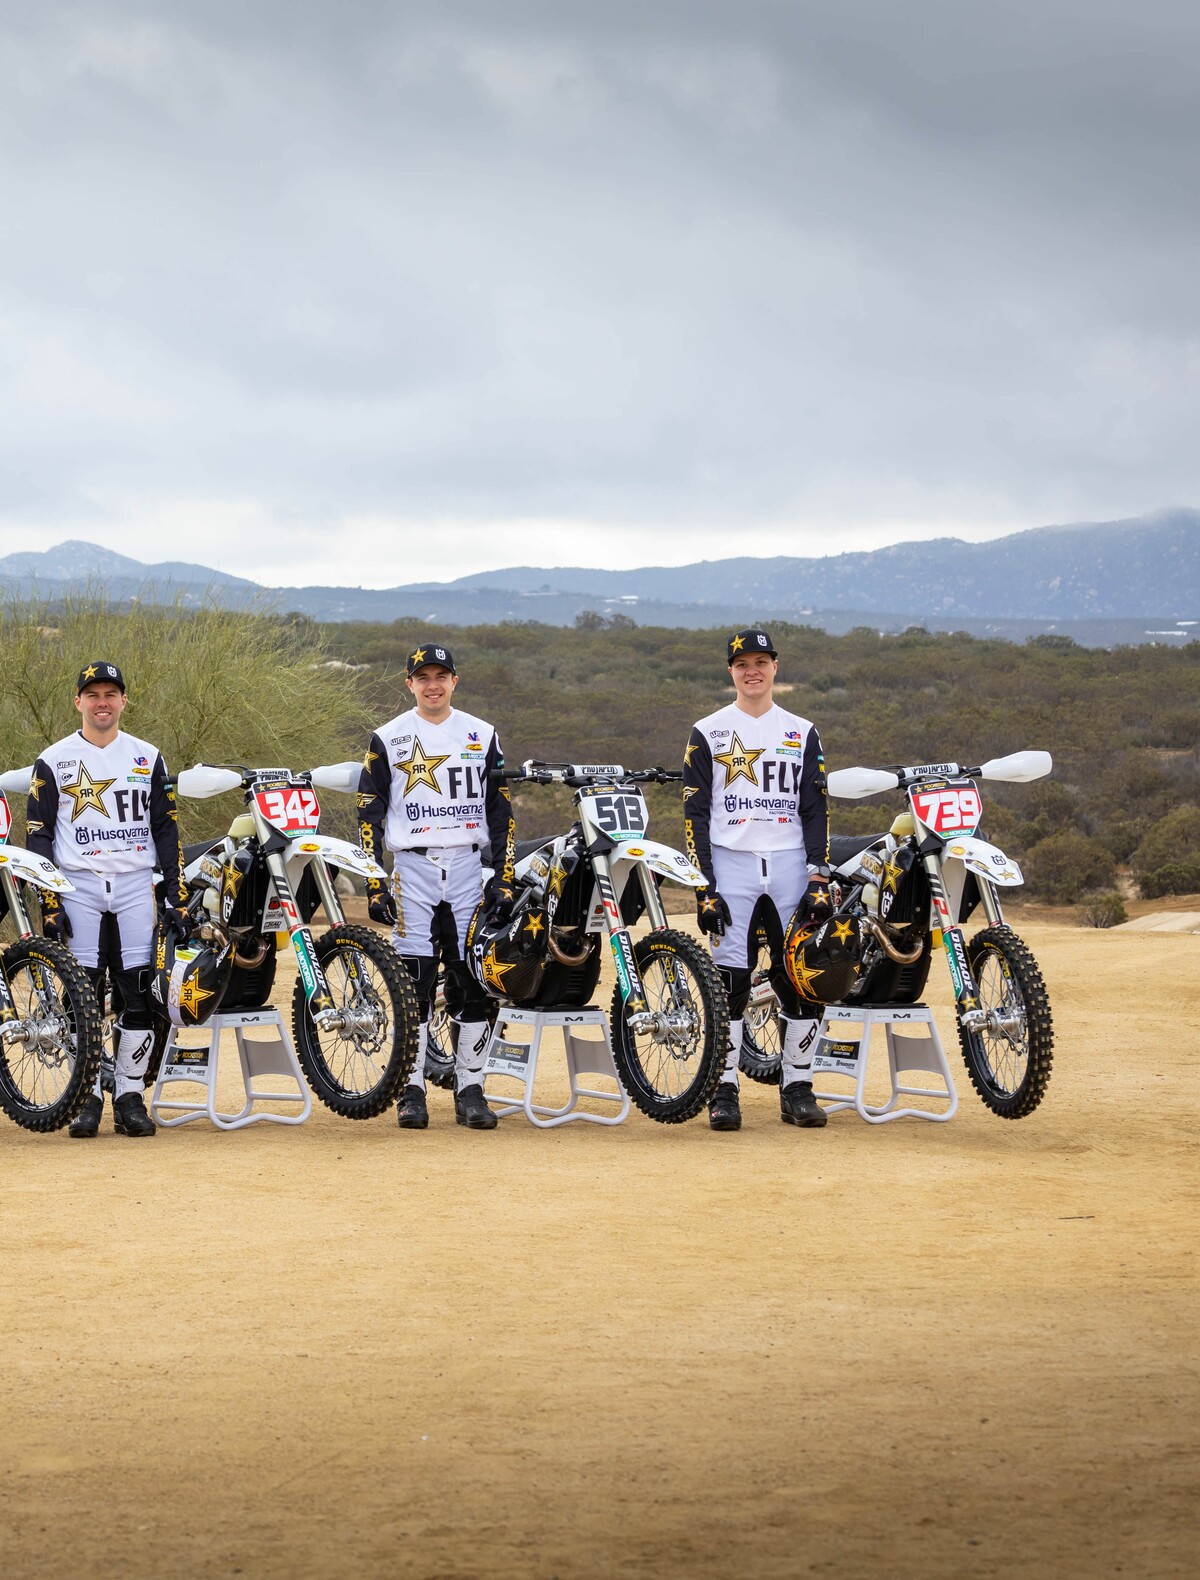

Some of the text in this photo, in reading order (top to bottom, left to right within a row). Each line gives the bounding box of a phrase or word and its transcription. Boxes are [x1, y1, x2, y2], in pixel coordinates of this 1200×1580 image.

[134, 757, 146, 766] VP
[763, 761, 802, 795] FLY
[447, 767, 484, 799] FLY
[265, 790, 319, 828] 342
[422, 803, 483, 818] Husqvarna
[595, 796, 645, 831] 513
[919, 790, 980, 832] 739
[92, 827, 149, 841] Husqvarna
[29, 951, 56, 968] DUNLOP
[302, 932, 327, 990] DUNLOP
[336, 939, 364, 950] DUNLOP
[650, 944, 676, 952] DUNLOP
[951, 932, 973, 991] DUNLOP
[298, 952, 314, 989] MOTOREX
[614, 954, 628, 992] MOTOREX
[619, 934, 640, 993] DUNLOP
[947, 952, 960, 991] MOTOREX
[182, 1051, 204, 1059] ROCKSTAR
[832, 1044, 854, 1052] ROCKSTAR
